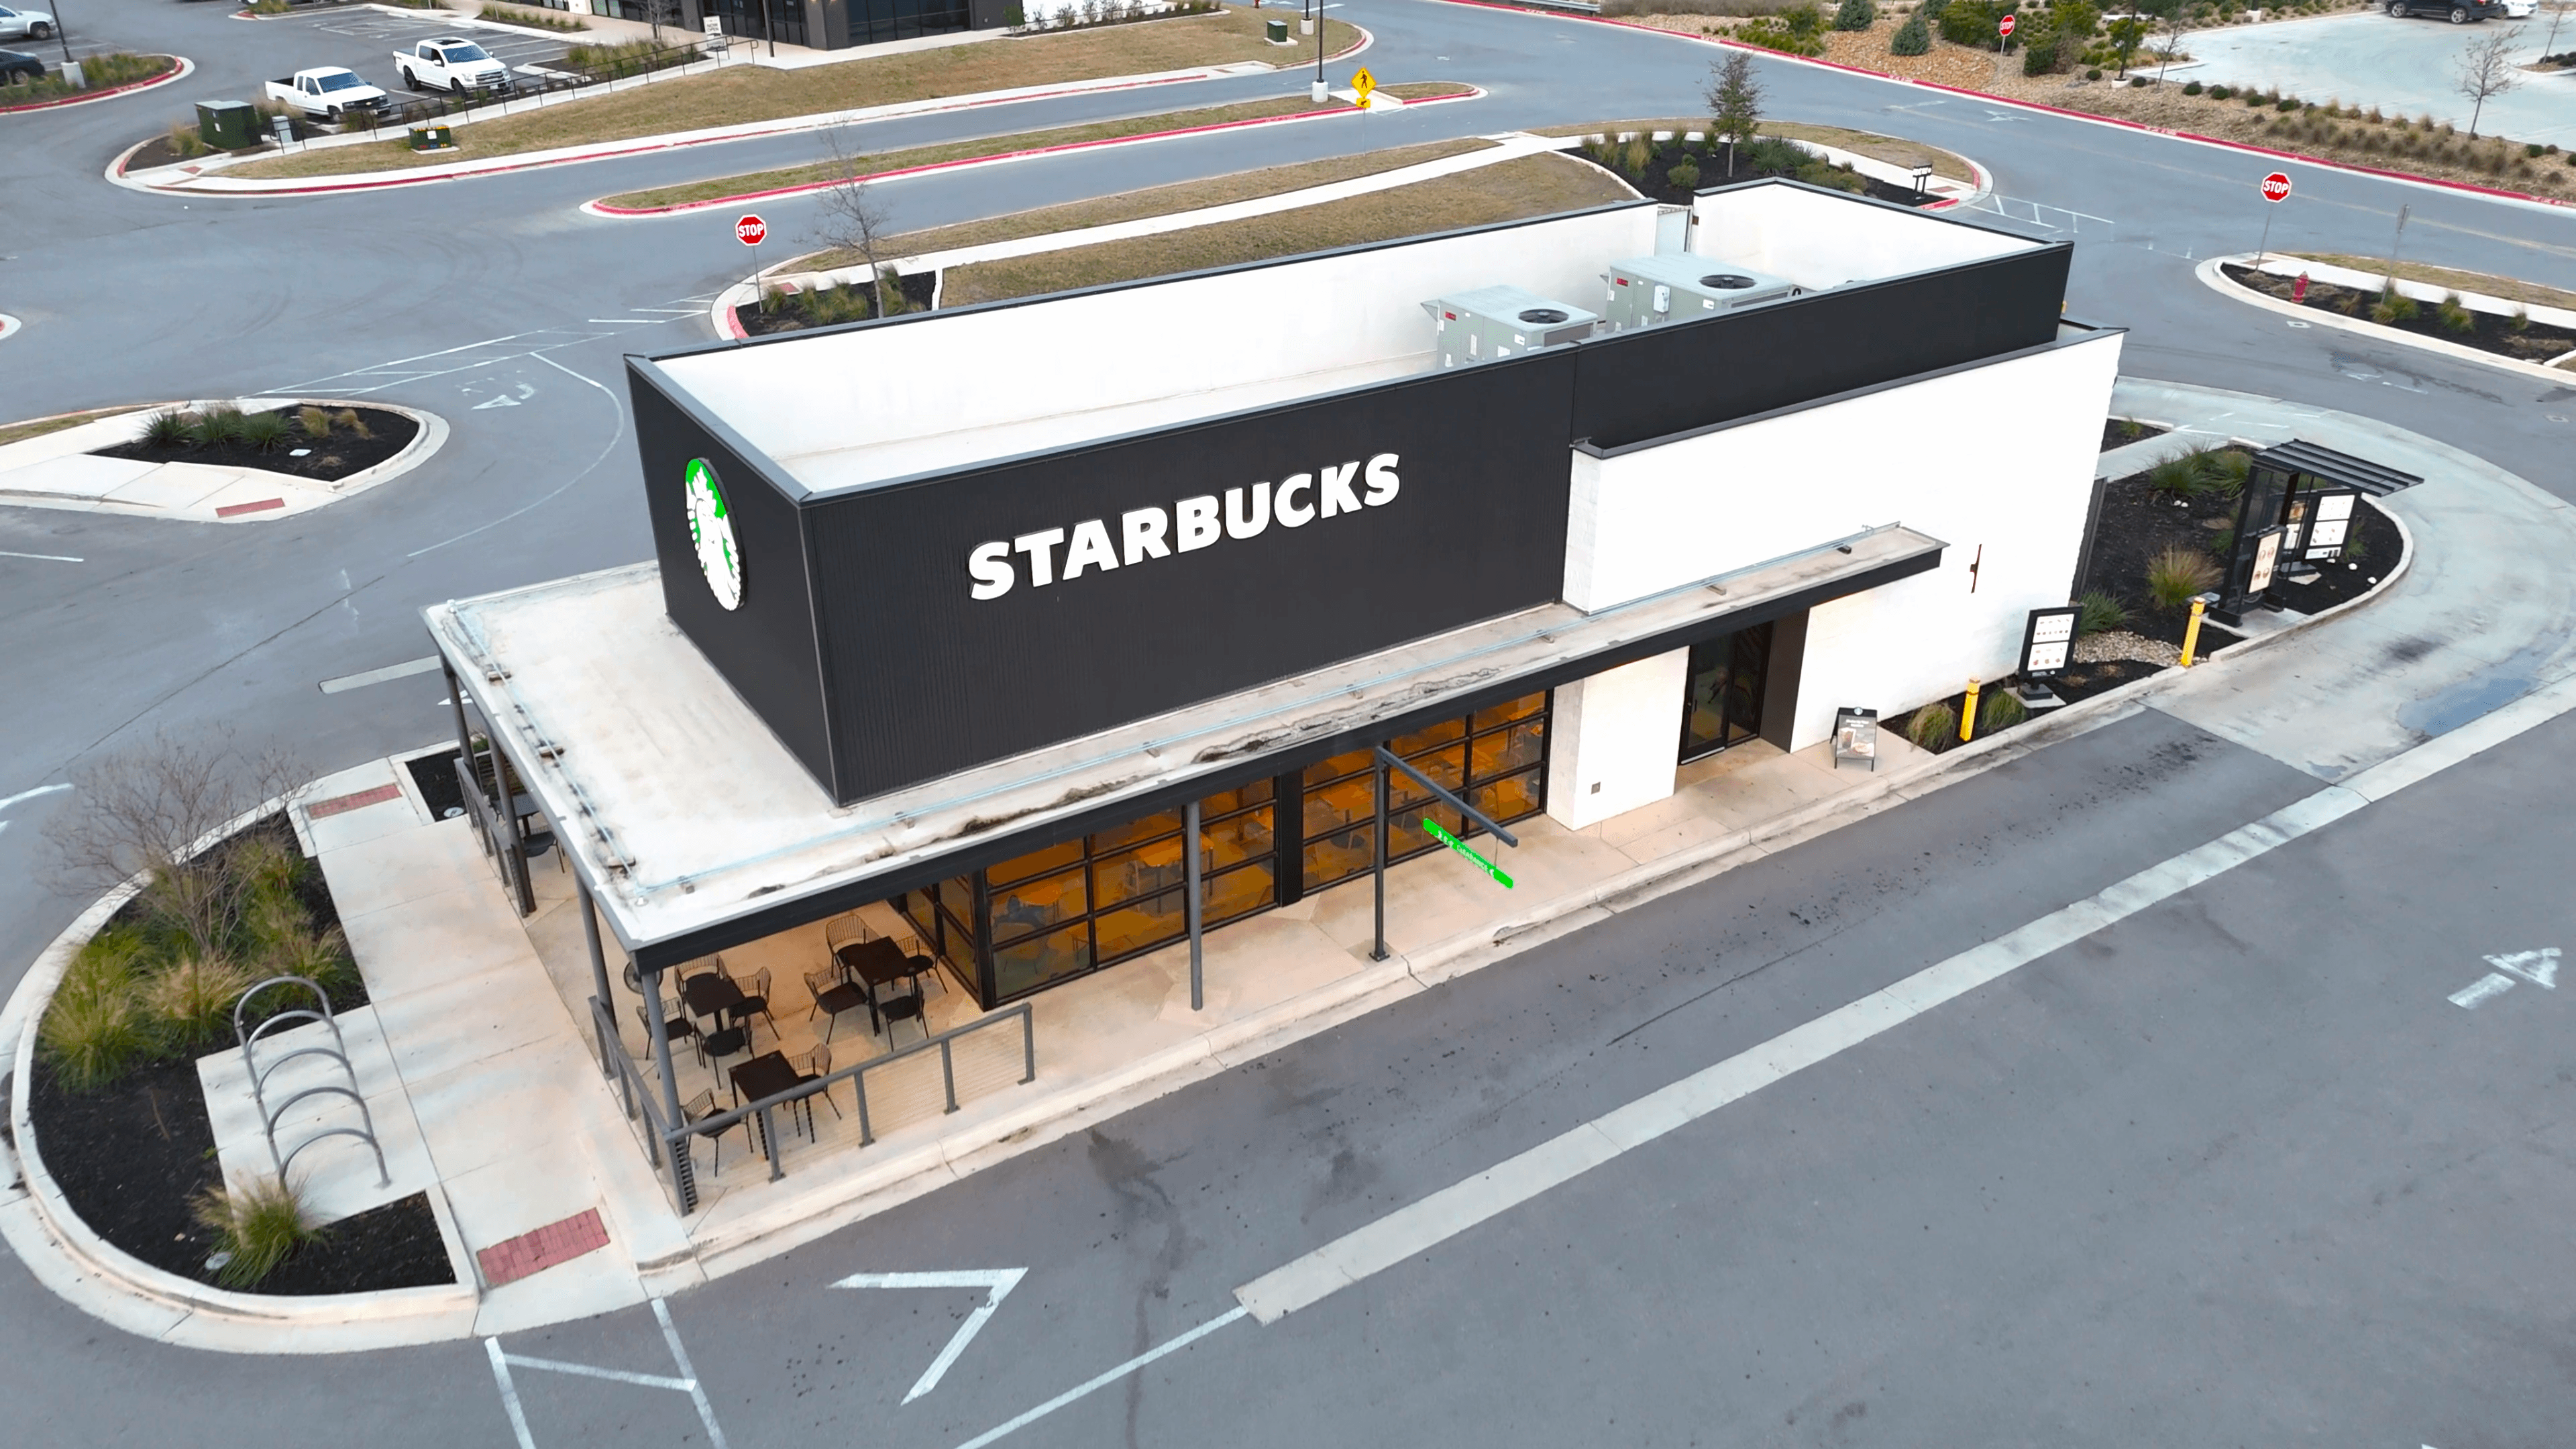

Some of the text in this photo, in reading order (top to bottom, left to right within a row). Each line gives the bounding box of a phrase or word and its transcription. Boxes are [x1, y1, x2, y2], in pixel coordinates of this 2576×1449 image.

[2000, 21, 2013, 30] STOP
[2263, 180, 2288, 194] STOP
[738, 223, 763, 237] STOP
[968, 453, 1400, 600] STARBUCKS
